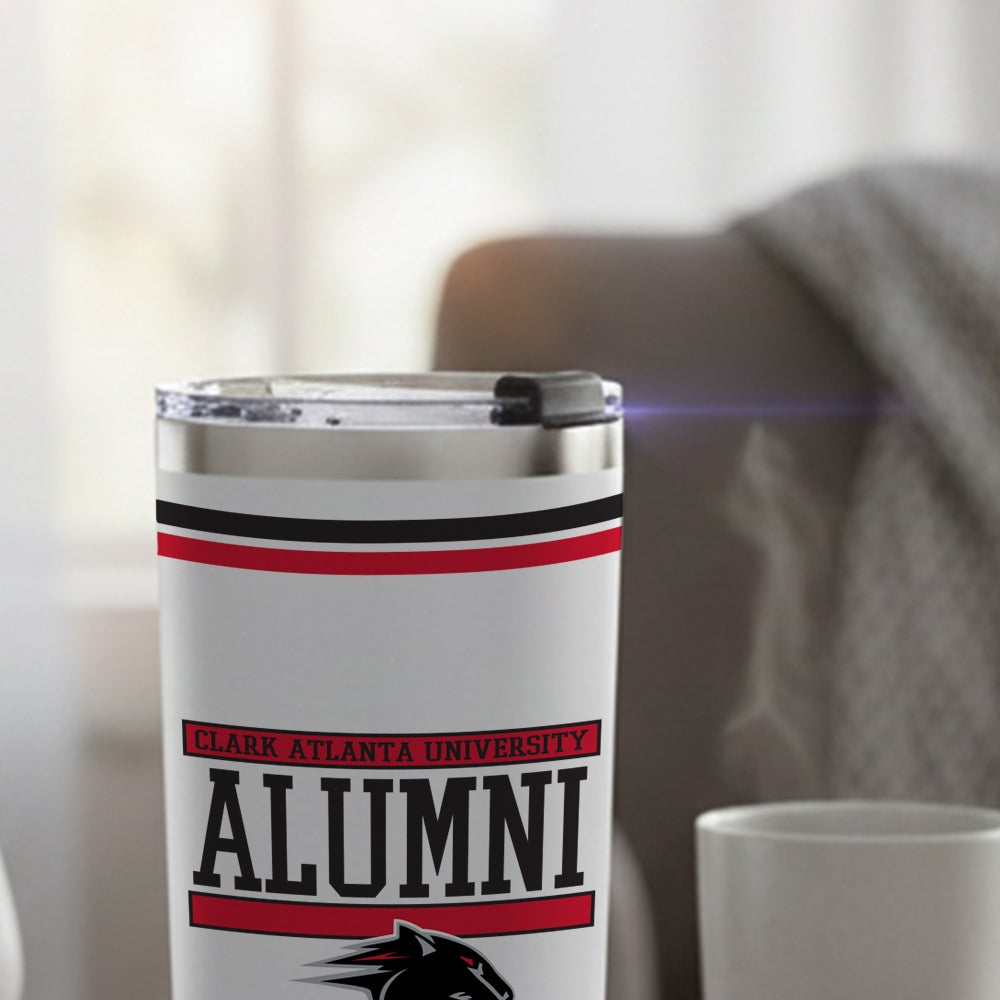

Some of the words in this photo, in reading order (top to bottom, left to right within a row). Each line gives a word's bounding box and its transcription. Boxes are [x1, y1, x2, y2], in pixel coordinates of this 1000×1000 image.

[194, 729, 278, 757] CLARK
[288, 738, 414, 762] ATLANTA
[424, 729, 589, 761] UNIVERSITY
[193, 766, 588, 898] ALUMNI
